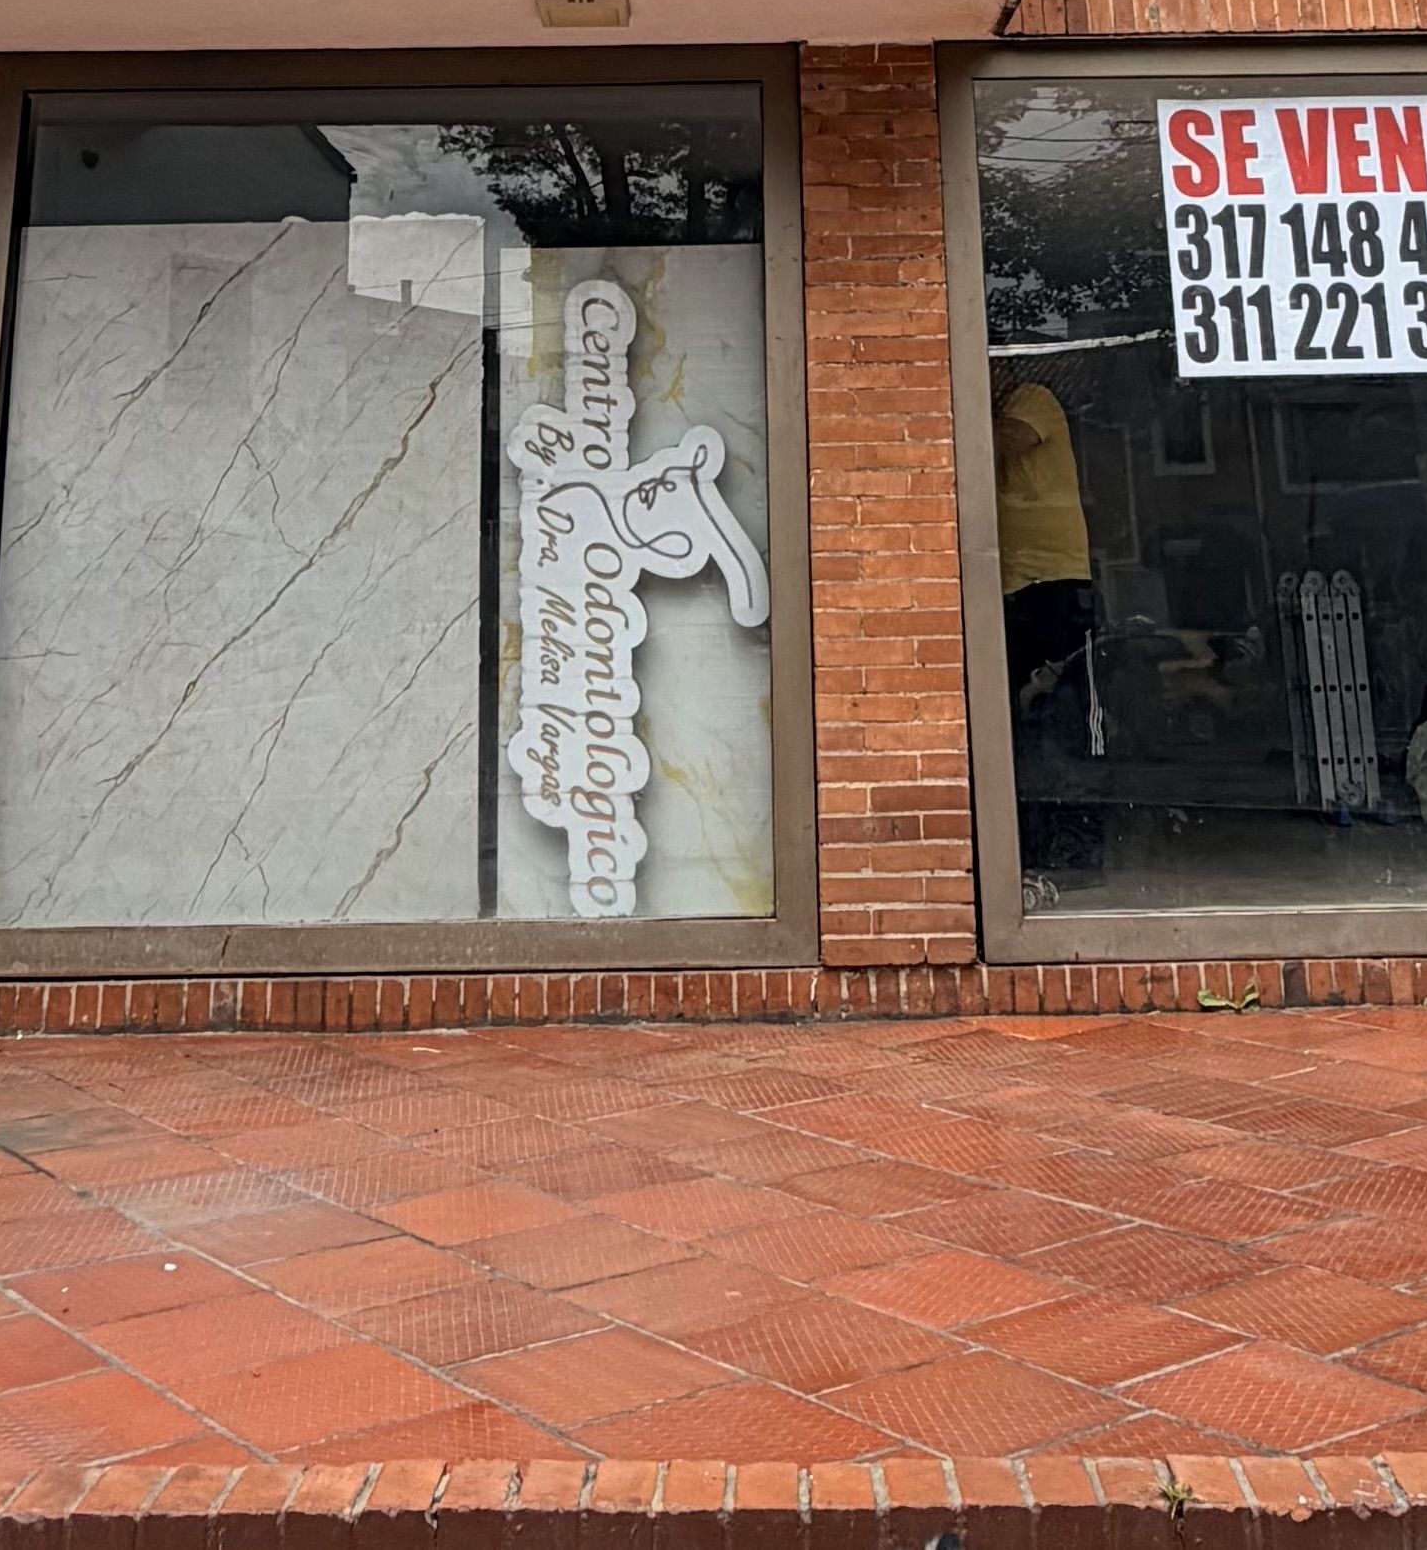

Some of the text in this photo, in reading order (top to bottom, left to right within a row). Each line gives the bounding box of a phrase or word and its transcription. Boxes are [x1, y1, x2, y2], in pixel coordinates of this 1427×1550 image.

[1168, 108, 1265, 198] SE
[1175, 203, 1266, 281] 317
[1280, 201, 1384, 277] 148
[1181, 284, 1277, 363] 311
[1289, 283, 1392, 360] 221
[537, 505, 574, 567] Dra.
[536, 585, 576, 686] Melisa
[570, 298, 631, 907] Centro Odontologico
[527, 703, 576, 807] Vargas
